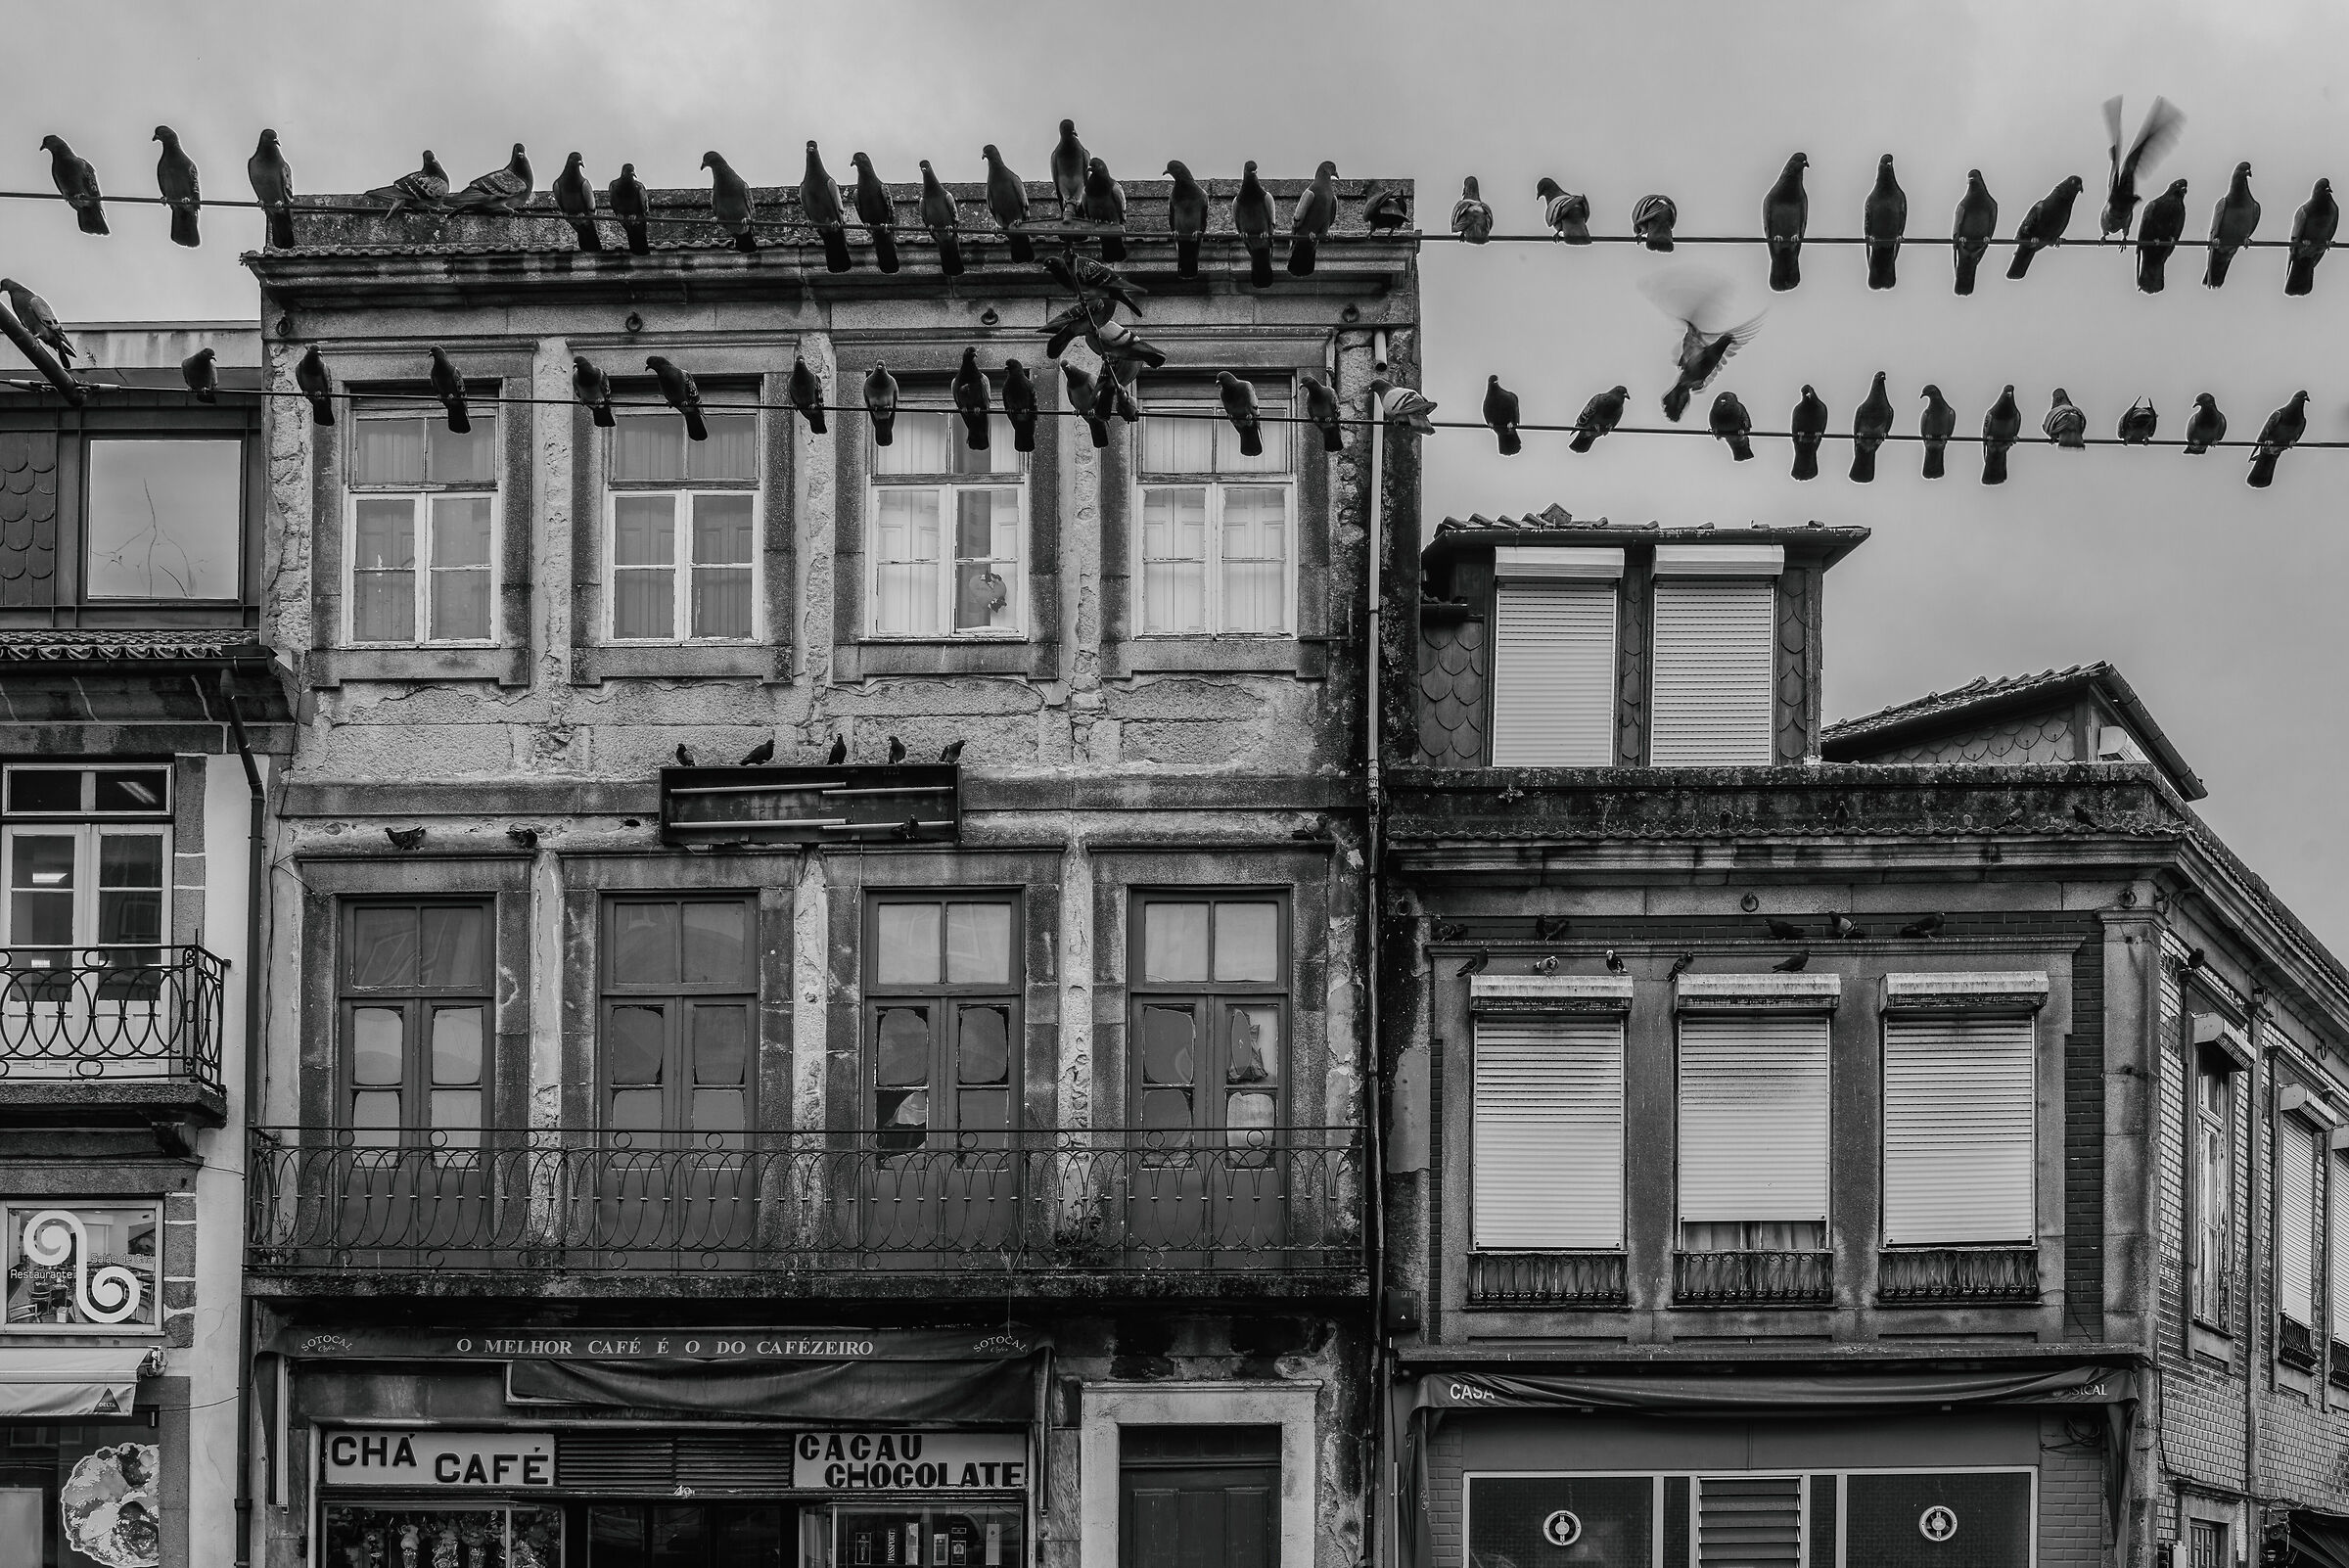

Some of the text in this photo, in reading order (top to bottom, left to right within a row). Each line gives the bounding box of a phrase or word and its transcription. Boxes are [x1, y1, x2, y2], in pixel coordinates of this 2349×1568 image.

[120, 1253, 132, 1264] de
[10, 1269, 72, 1279] Restaurante
[300, 1334, 353, 1352] SOTOCAL
[456, 1337, 874, 1356] O MELHOR CAFÉ É O DO CAFÉZEIRO
[973, 1335, 1027, 1353] SOTOCAL
[1450, 1383, 1496, 1400] CASA
[332, 1433, 418, 1467] CHÁ
[799, 1434, 922, 1461] CACAU
[435, 1447, 549, 1485] CAFÉ
[824, 1461, 1025, 1489] CHOCOLATE
